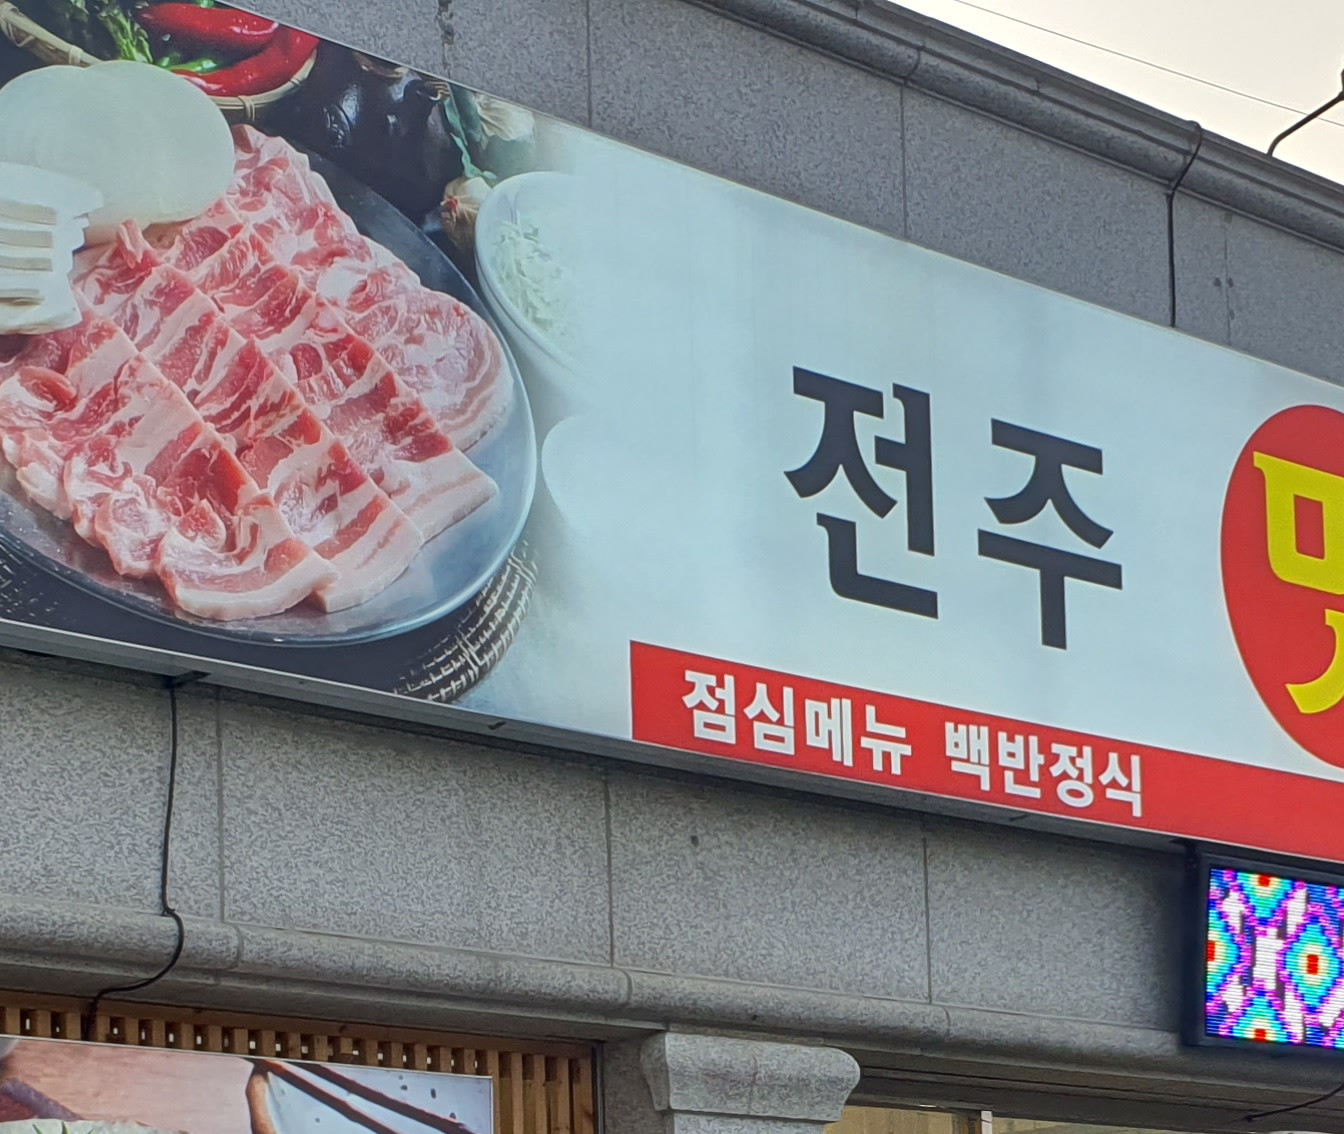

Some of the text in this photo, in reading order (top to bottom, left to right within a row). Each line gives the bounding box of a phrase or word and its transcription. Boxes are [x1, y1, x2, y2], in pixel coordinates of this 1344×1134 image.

[784, 366, 1123, 650] 전주
[682, 669, 1143, 817] 점심메뉴 백반정식
